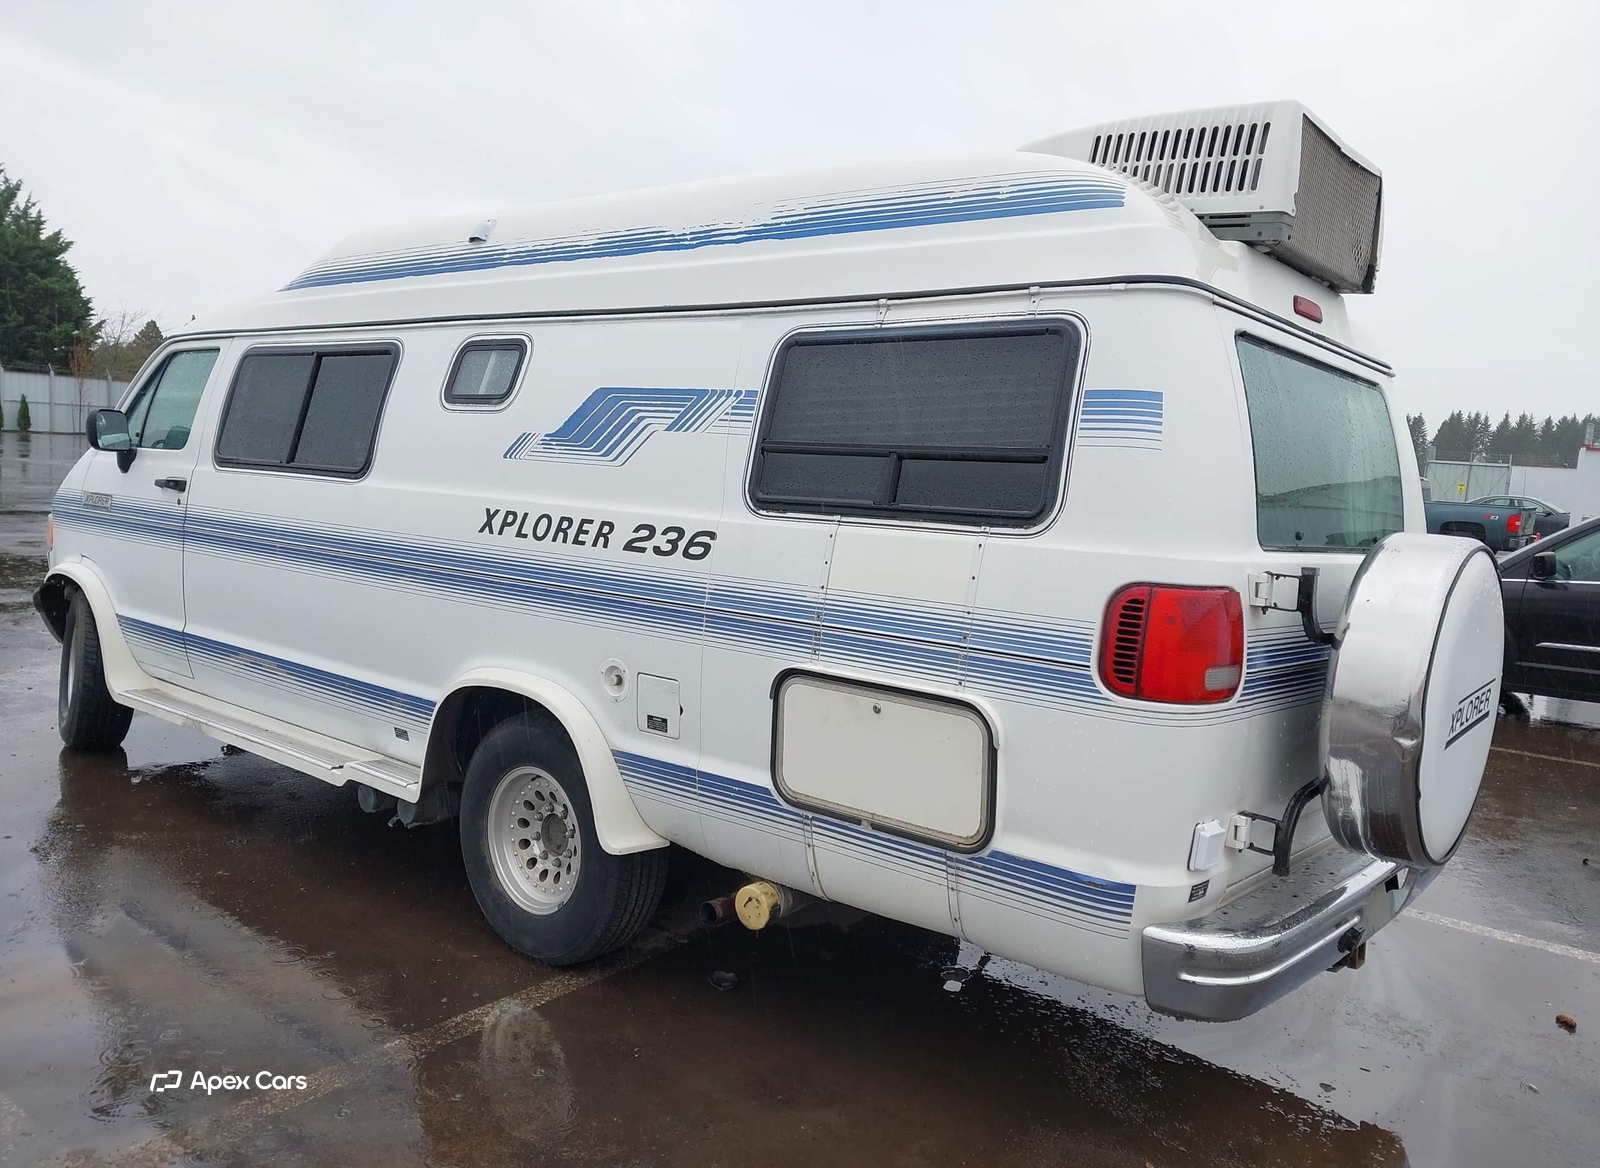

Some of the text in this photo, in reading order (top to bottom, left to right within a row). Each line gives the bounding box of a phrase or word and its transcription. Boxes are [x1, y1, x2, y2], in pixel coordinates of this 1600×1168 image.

[478, 507, 718, 561] XPLORER 236
[1448, 687, 1492, 737] XPLORER
